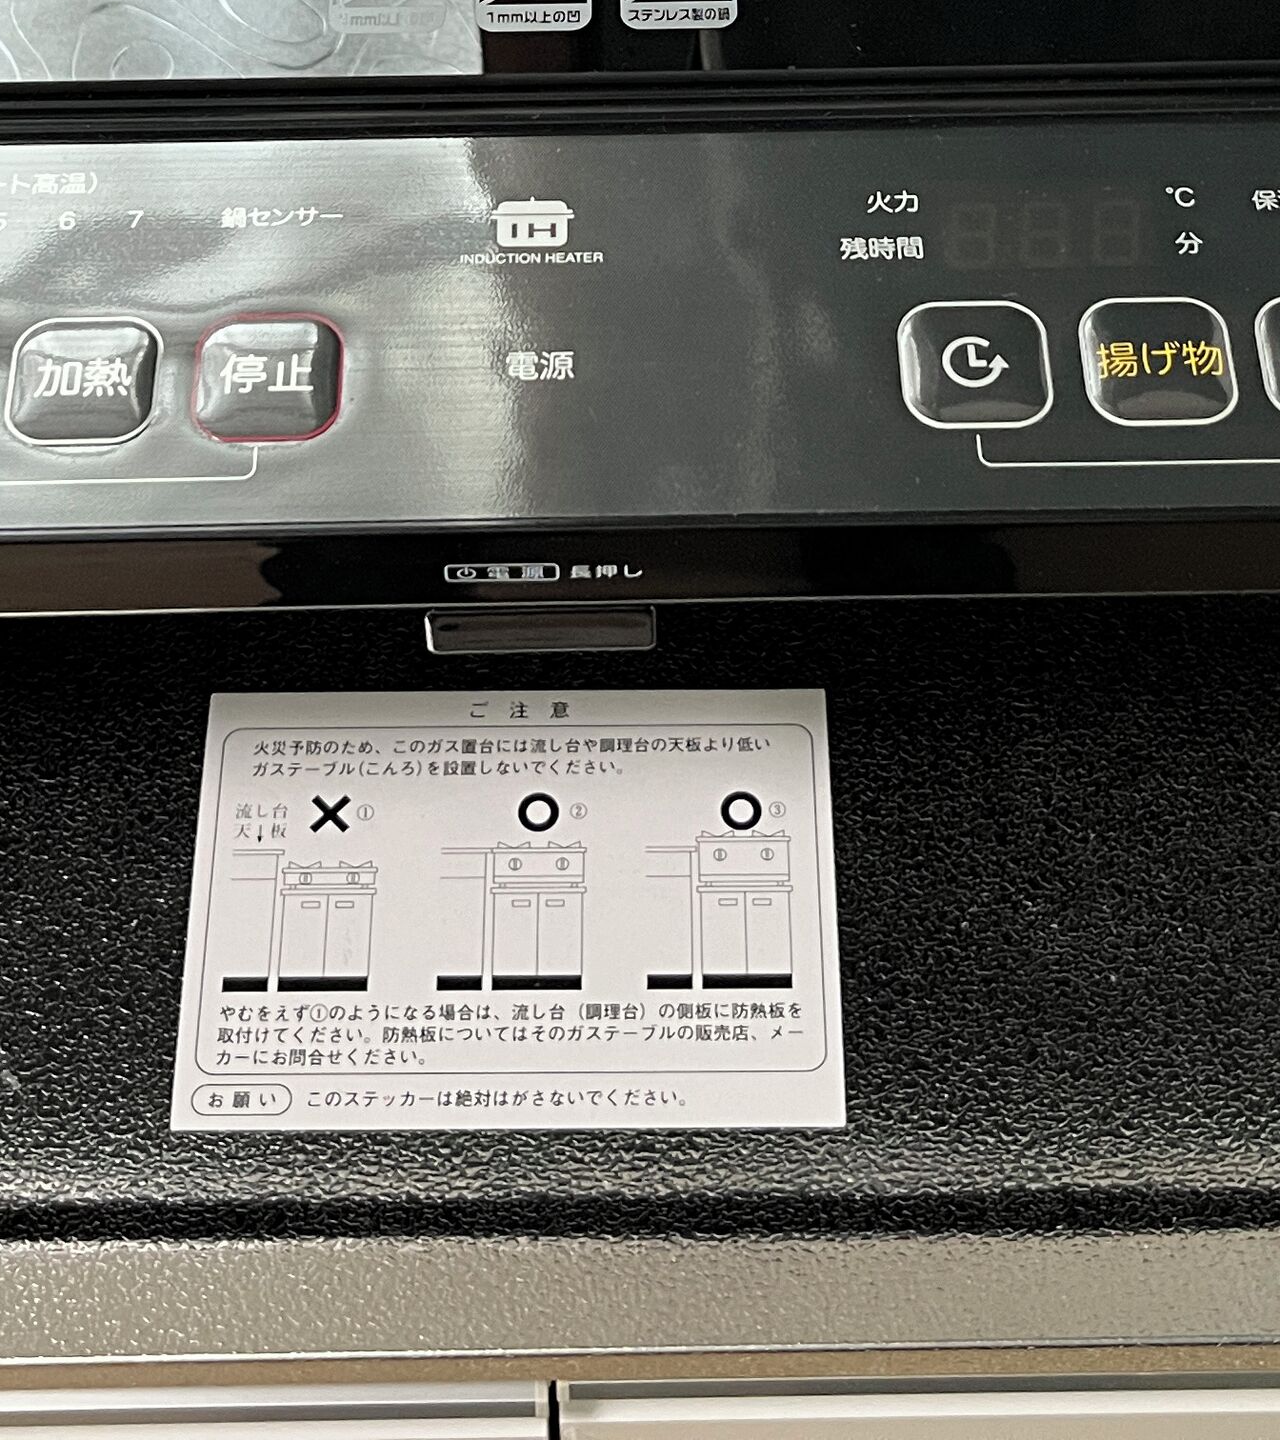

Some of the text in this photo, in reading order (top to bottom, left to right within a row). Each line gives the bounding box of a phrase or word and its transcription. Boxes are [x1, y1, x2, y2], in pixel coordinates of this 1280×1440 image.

[486, 9, 581, 25] 1mm以上の凹
[627, 7, 731, 22] ステンレス製の鍋
[866, 191, 919, 214] 火力
[58, 211, 77, 229] 6
[127, 210, 145, 229] 7
[220, 206, 344, 228] 鍋センサー
[511, 222, 557, 239] IH
[840, 236, 924, 260] 残時間
[1175, 231, 1204, 255] 分
[460, 251, 604, 264] INDUCTION HEATER
[505, 351, 575, 381] 電源
[1096, 341, 1224, 379] 揚げ物
[33, 357, 133, 398] 加熱
[219, 355, 315, 396] 停止
[216, 1047, 426, 1067] カーにお問合せください。
